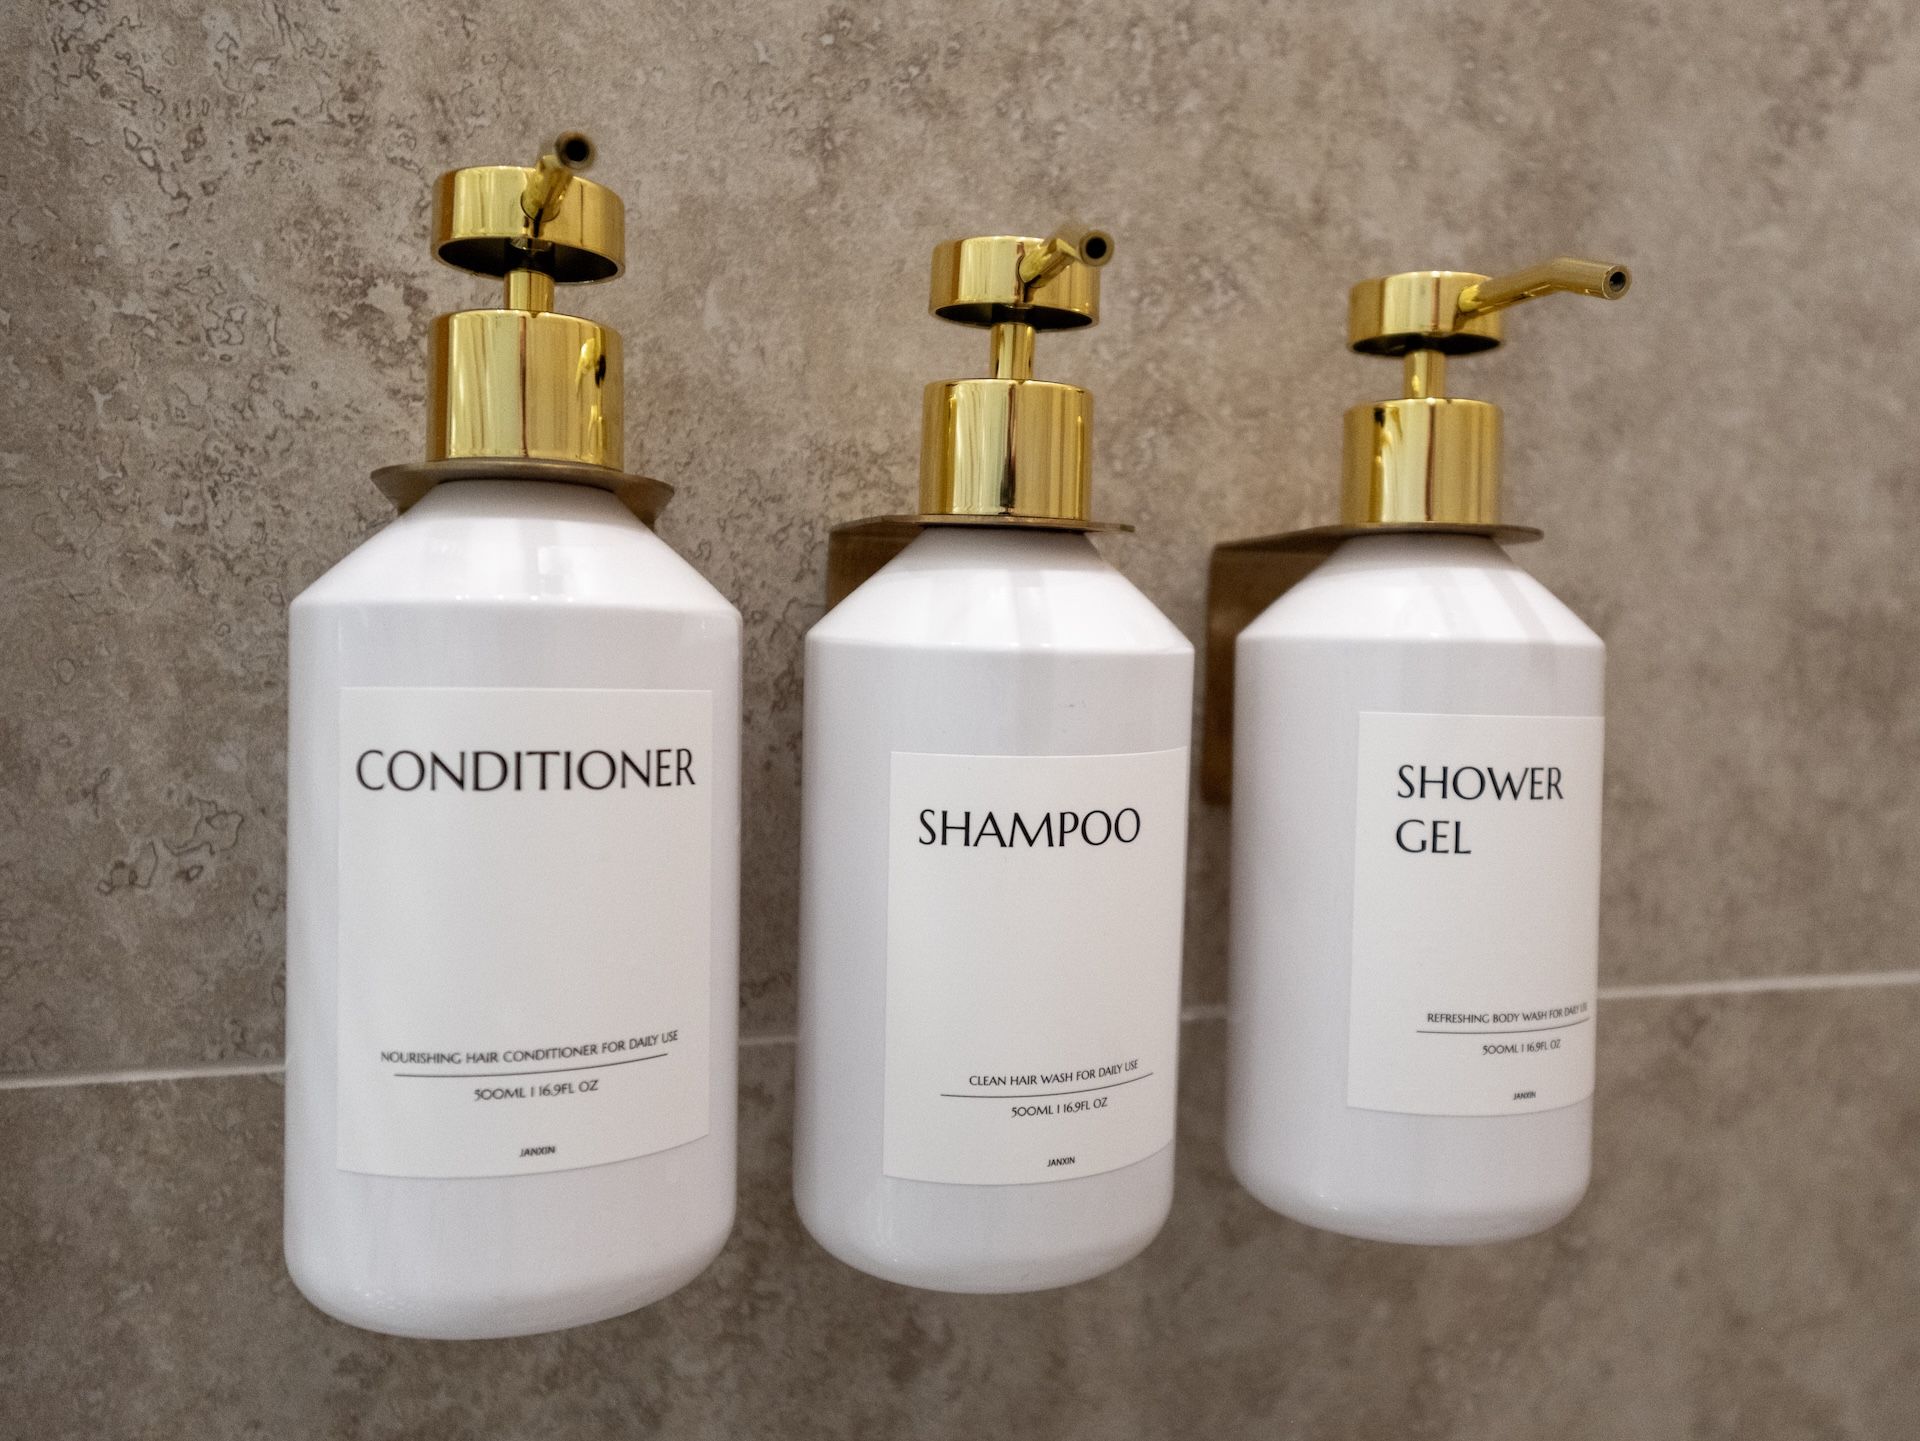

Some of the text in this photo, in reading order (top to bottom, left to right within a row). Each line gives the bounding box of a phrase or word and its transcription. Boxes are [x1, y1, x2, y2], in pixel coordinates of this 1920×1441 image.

[355, 748, 697, 792] CONDITIONER
[1397, 764, 1565, 801] SHOWER
[918, 807, 1142, 848] SHAMPOO
[1395, 818, 1473, 855] GEL
[1426, 1012, 1490, 1025] REFRESHING
[1492, 1012, 1521, 1024] BODY
[1521, 1010, 1548, 1022] WASH
[1548, 1008, 1564, 1020] FOR
[380, 1029, 679, 1066] NOURISHING HAIR CONDITIONER FOR DAILY USE
[1482, 1043, 1519, 1056] 500ML
[1526, 1040, 1548, 1053] 16.9FL
[1549, 1038, 1562, 1050] OZ
[968, 1058, 1139, 1087] CLEAN HAIR WASH FOR DAILY USE
[473, 1087, 527, 1102] 500ML
[538, 1082, 575, 1098] 16.9FL
[578, 1079, 600, 1094] OZ
[1513, 1090, 1537, 1101] JANXIN
[1011, 1104, 1054, 1118] 500ML
[1062, 1100, 1091, 1115] 16.9FL
[1092, 1096, 1108, 1109] OZ
[519, 1145, 557, 1158] JANXIN
[1046, 1156, 1076, 1168] JANXIN
